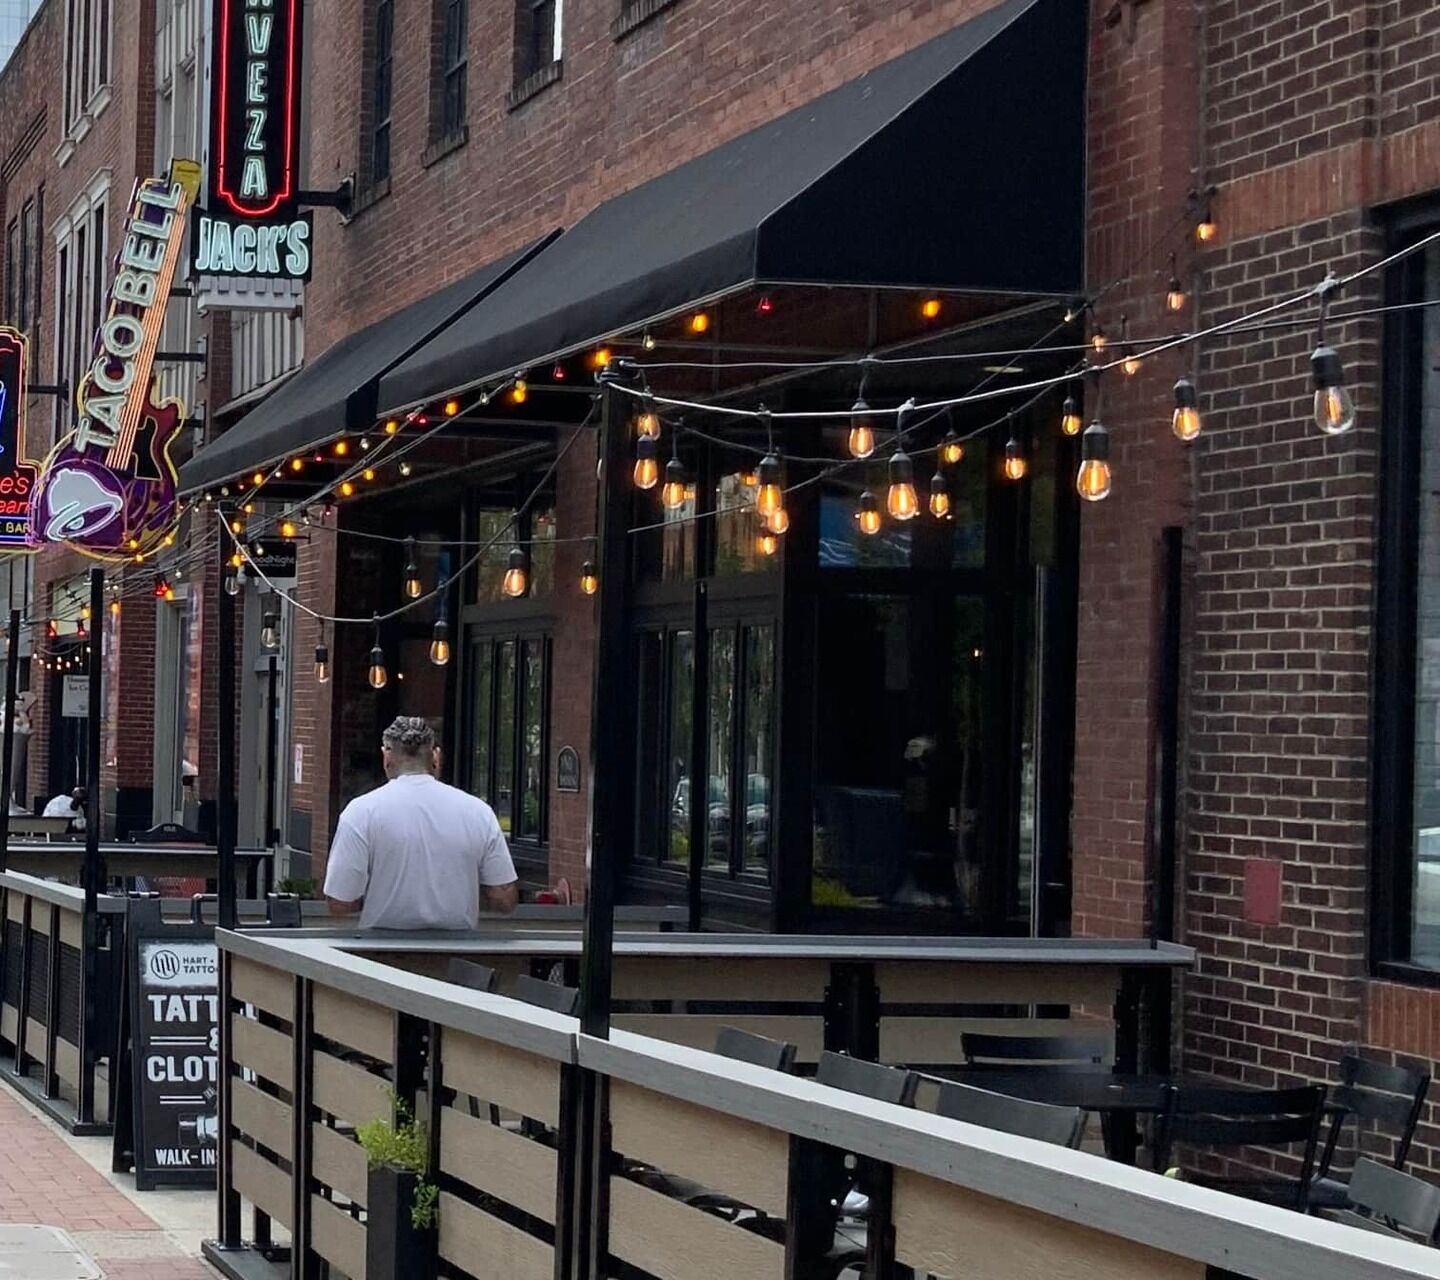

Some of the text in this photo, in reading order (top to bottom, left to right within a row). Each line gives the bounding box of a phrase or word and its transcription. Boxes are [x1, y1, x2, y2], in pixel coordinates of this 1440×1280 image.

[195, 217, 310, 276] JACK'S
[73, 180, 183, 455] TACO BELL
[5, 521, 31, 533] BAR
[183, 956, 207, 965] HART
[183, 965, 218, 974] TATTO
[148, 994, 219, 1022] TATT
